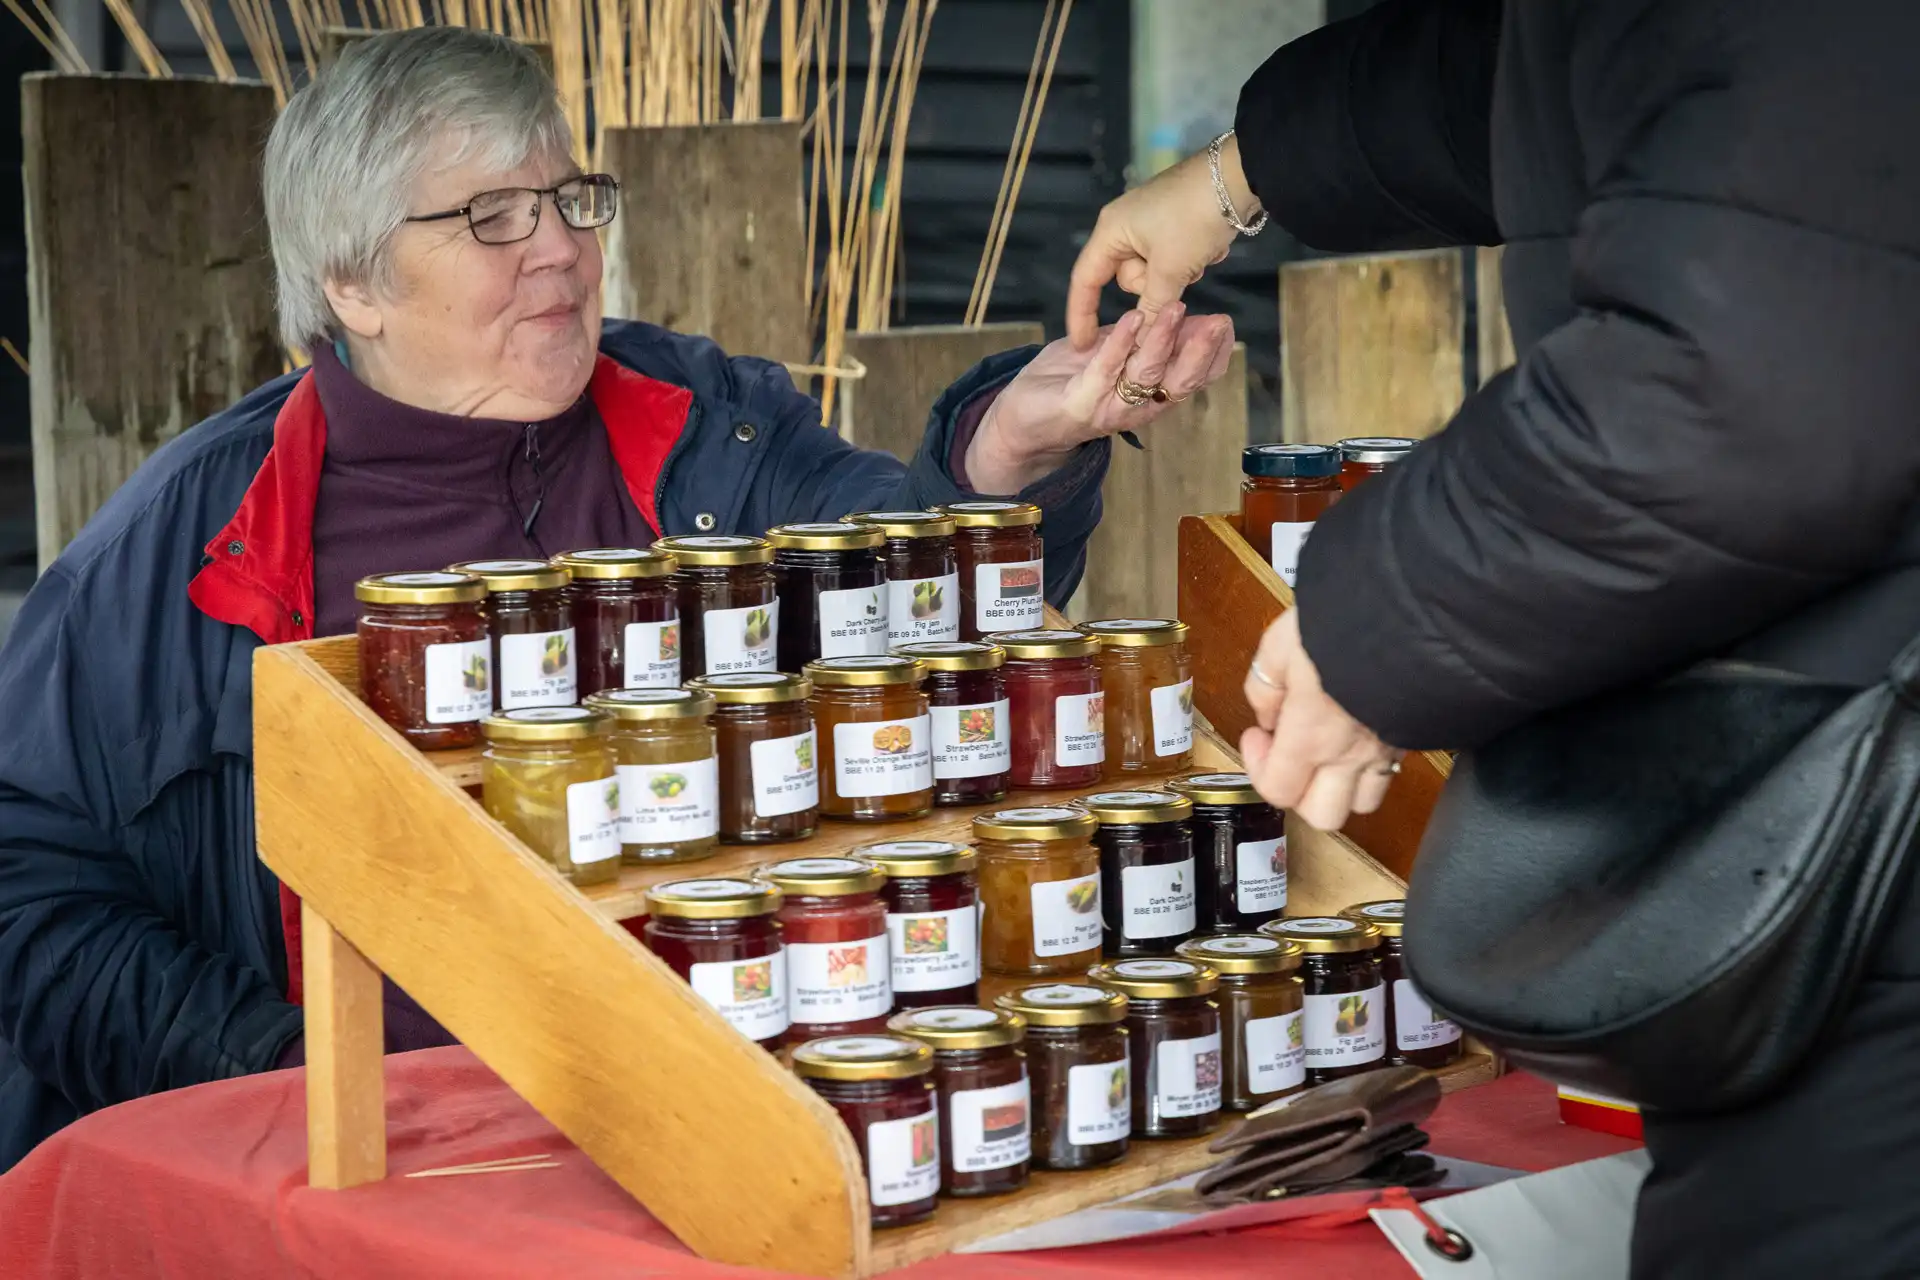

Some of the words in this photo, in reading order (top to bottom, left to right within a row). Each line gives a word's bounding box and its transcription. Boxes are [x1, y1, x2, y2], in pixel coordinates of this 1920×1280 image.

[914, 621, 926, 629] Fig
[929, 620, 940, 628] jam
[831, 629, 846, 637] BBE
[927, 628, 944, 636] Batch
[747, 652, 757, 660] Fig
[715, 663, 732, 671] BBE
[510, 689, 528, 698] BBE
[1064, 734, 1095, 743] Strawberry
[945, 744, 990, 754] Strawberry
[991, 741, 1003, 749] Jam
[1161, 739, 1175, 748] BBE
[844, 757, 870, 765] Seville
[872, 756, 899, 765] Orange
[845, 766, 862, 775] BBE
[1133, 907, 1150, 915] BBE
[892, 955, 940, 965] trawberry
[1339, 1038, 1351, 1046] Fig
[1403, 1035, 1419, 1043] BBE
